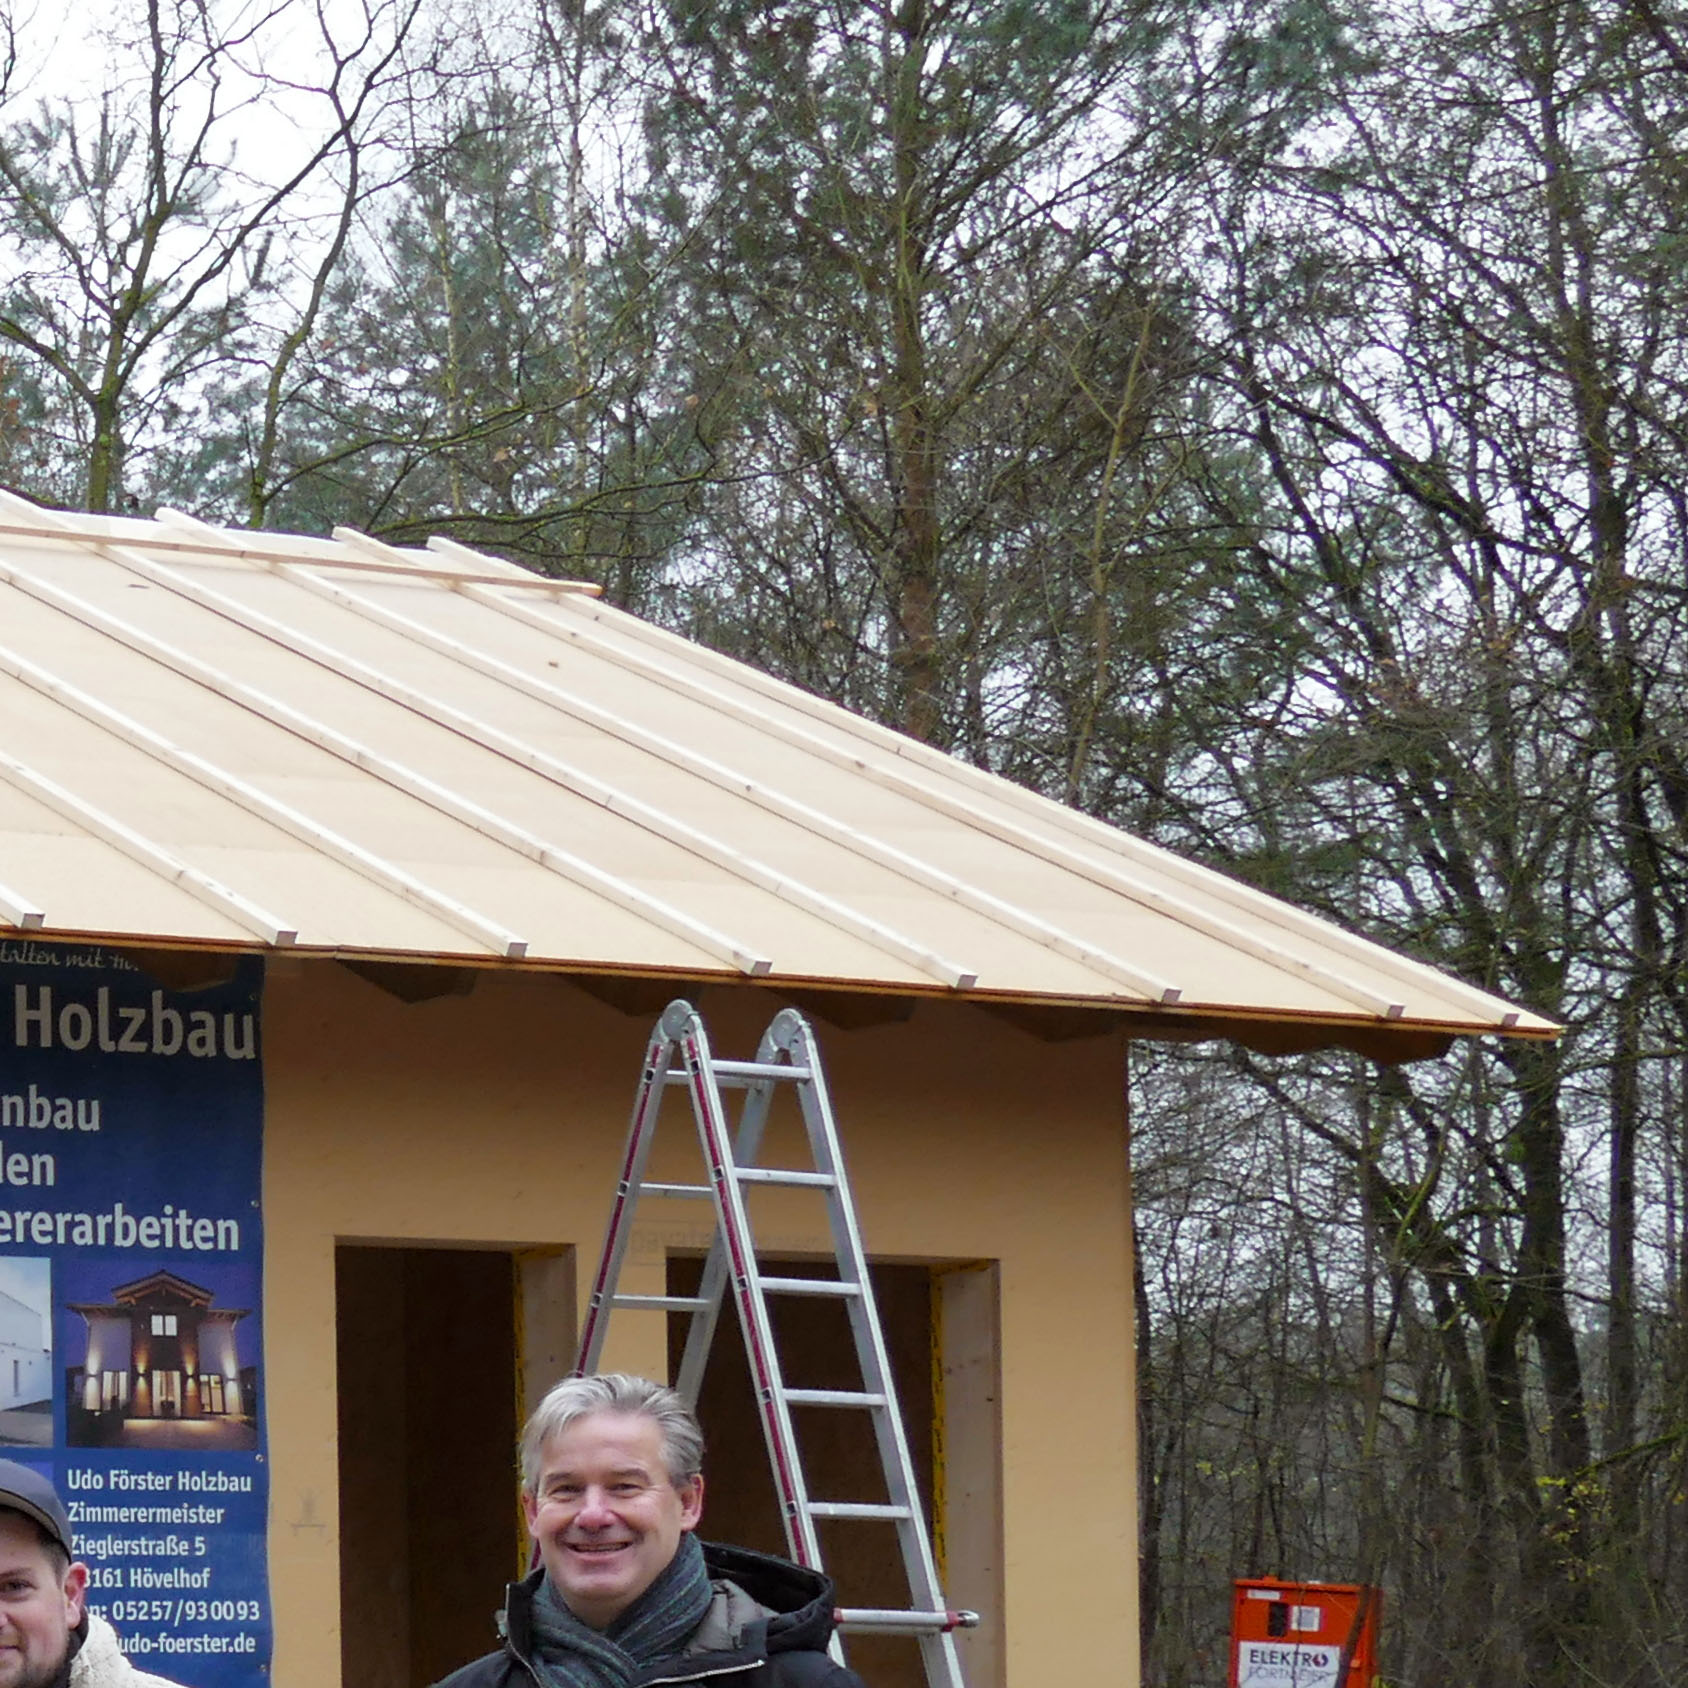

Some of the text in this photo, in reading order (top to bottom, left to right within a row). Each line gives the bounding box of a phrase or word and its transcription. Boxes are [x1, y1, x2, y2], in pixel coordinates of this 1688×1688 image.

[66, 948, 105, 969] mit
[14, 984, 256, 1060] Holzbau
[67, 1469, 252, 1492] Udo Förster Holzbau
[68, 1502, 225, 1524] Zimmerermeister
[71, 1534, 206, 1560] Zieglerstraße 5
[85, 1567, 211, 1588] 3161 Hövelhof
[118, 1631, 256, 1653] udo-foerster.de
[1250, 1649, 1330, 1669] ELEKTRO
